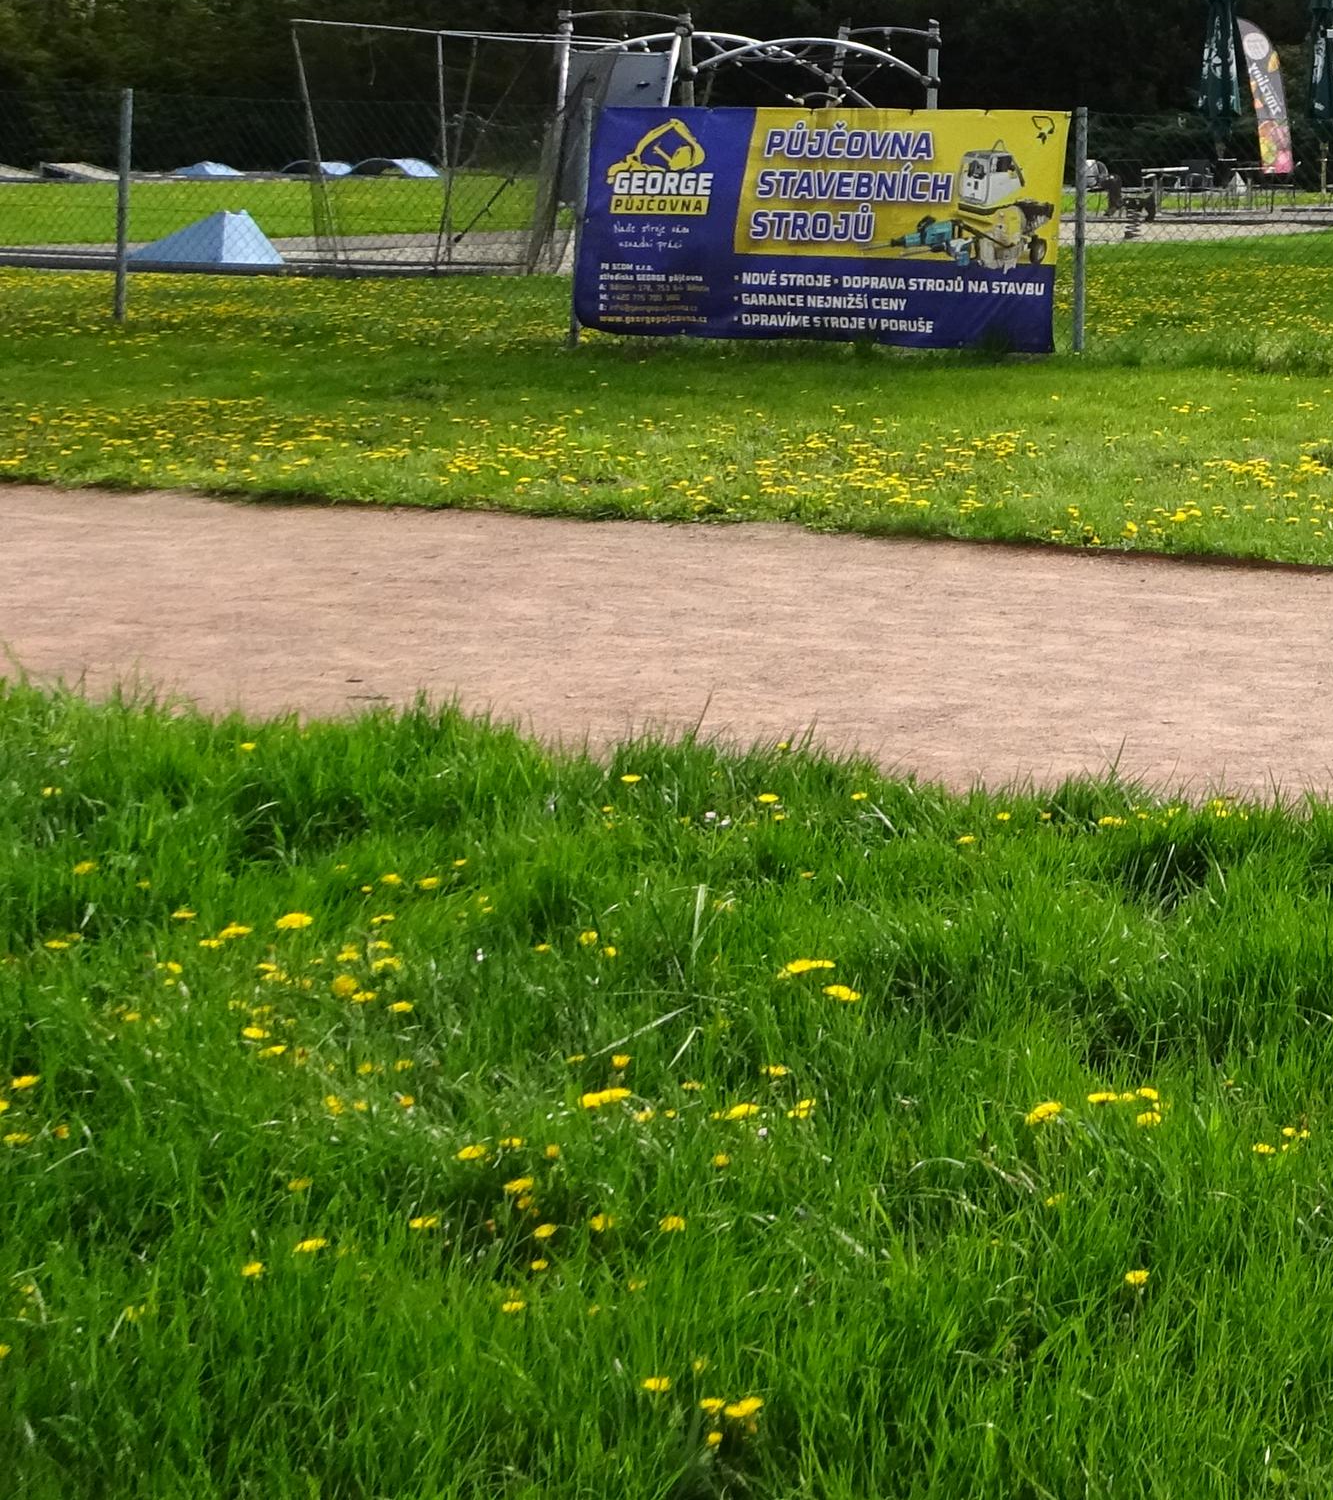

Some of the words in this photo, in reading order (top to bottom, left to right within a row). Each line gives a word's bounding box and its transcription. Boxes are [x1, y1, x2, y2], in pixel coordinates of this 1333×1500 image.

[765, 121, 934, 159] PŮJČOVNA
[613, 171, 714, 195] GEORGE
[757, 162, 954, 202] STAVEBNÍCH
[614, 195, 703, 212] PŮJČOVNA
[751, 203, 876, 242] STROJŮ
[742, 270, 777, 286] NOVÉ
[780, 273, 831, 287] STROJE
[842, 276, 906, 290] DOPRAVA
[908, 276, 964, 292] STROJŮ
[968, 281, 989, 293] NA
[991, 281, 1045, 296] STAVBU
[741, 293, 804, 307] GARANCE
[807, 293, 869, 309] NEJNIŽŠÍ
[872, 297, 907, 311] CENY
[742, 311, 811, 327] OPRAVÍME
[813, 316, 866, 330] STROJE
[868, 318, 878, 330] V
[880, 317, 934, 333] PORUŠE
